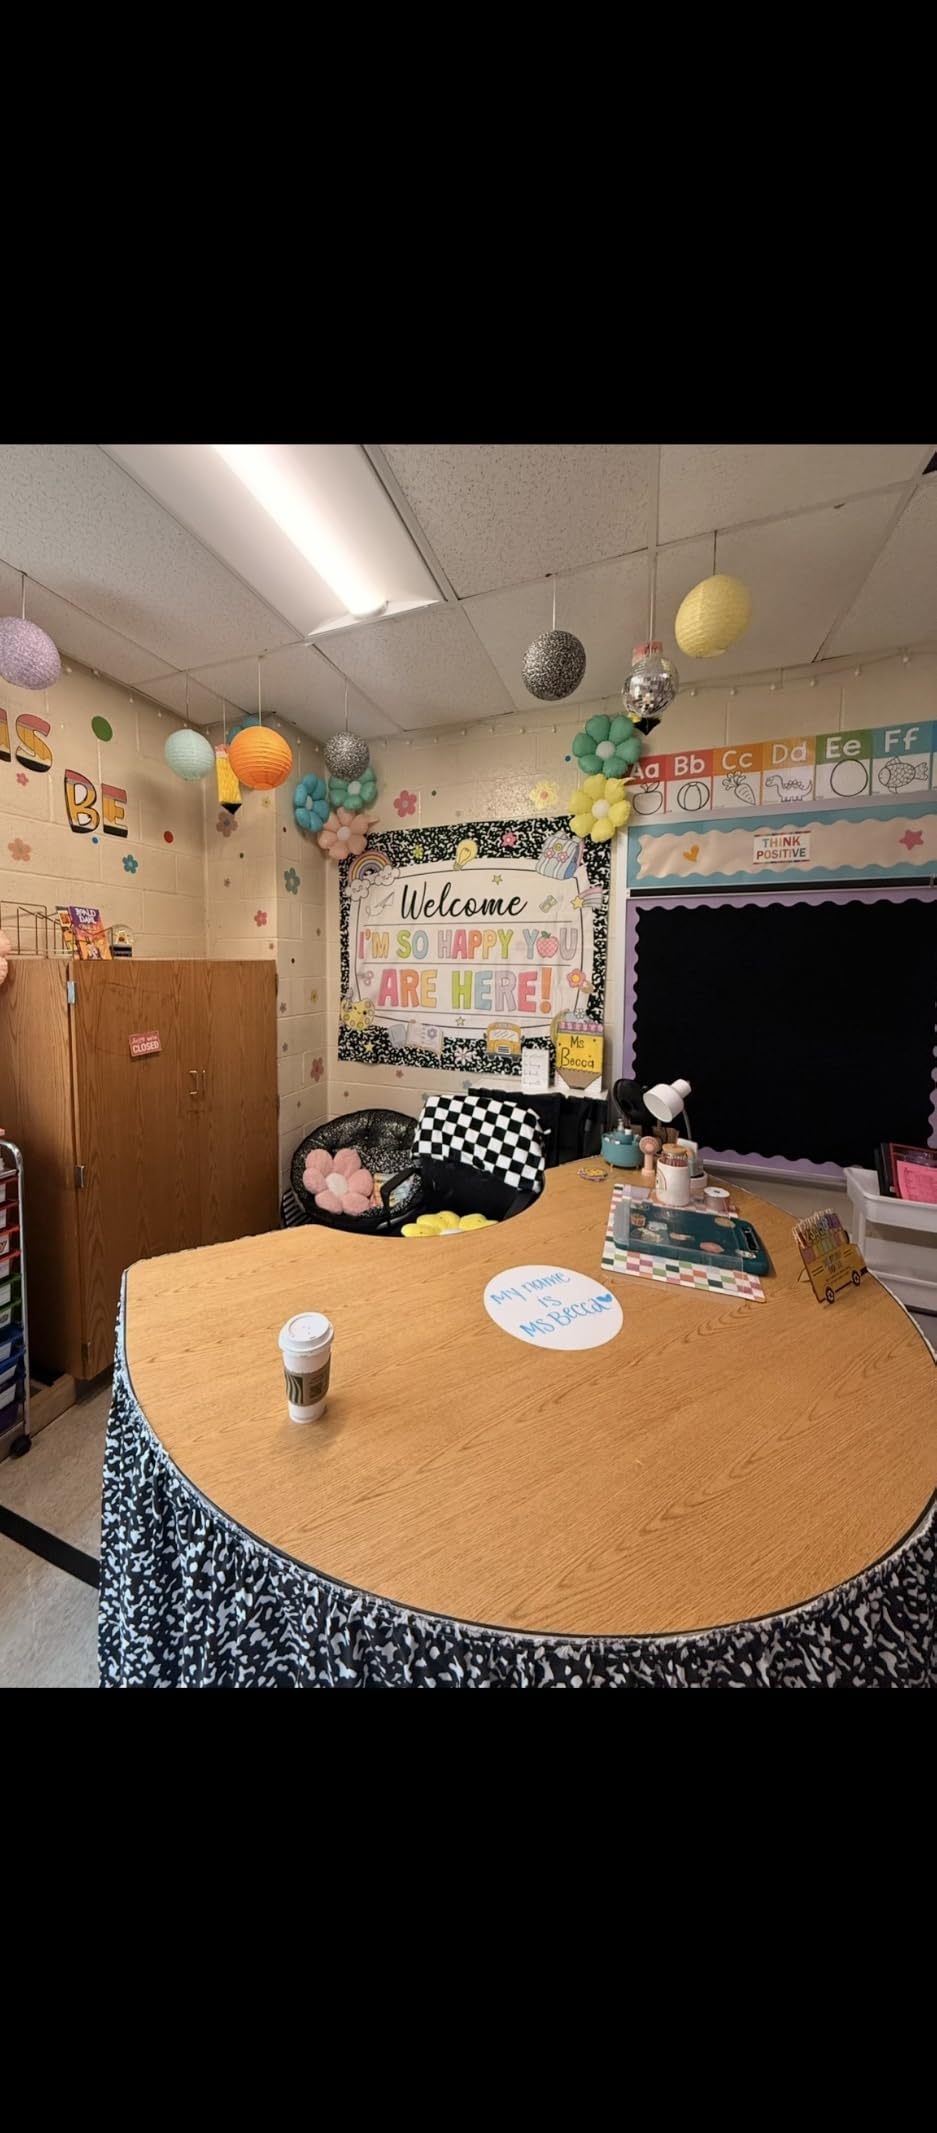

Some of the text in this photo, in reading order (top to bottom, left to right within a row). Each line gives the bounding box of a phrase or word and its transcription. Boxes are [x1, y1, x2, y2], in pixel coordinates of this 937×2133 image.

[630, 727, 920, 780] Aa Bb Cc Dd Ee Ff
[64, 768, 128, 839] BE
[756, 847, 807, 860] POSITIVE
[761, 836, 801, 848] THINK
[400, 880, 528, 921] Welcome
[358, 929, 390, 960] I'M
[396, 929, 429, 960] SO
[437, 928, 514, 960] HAPPY
[377, 967, 552, 1014] ARE HERE!
[570, 1035, 584, 1049] Ms
[522, 1272, 570, 1293] name
